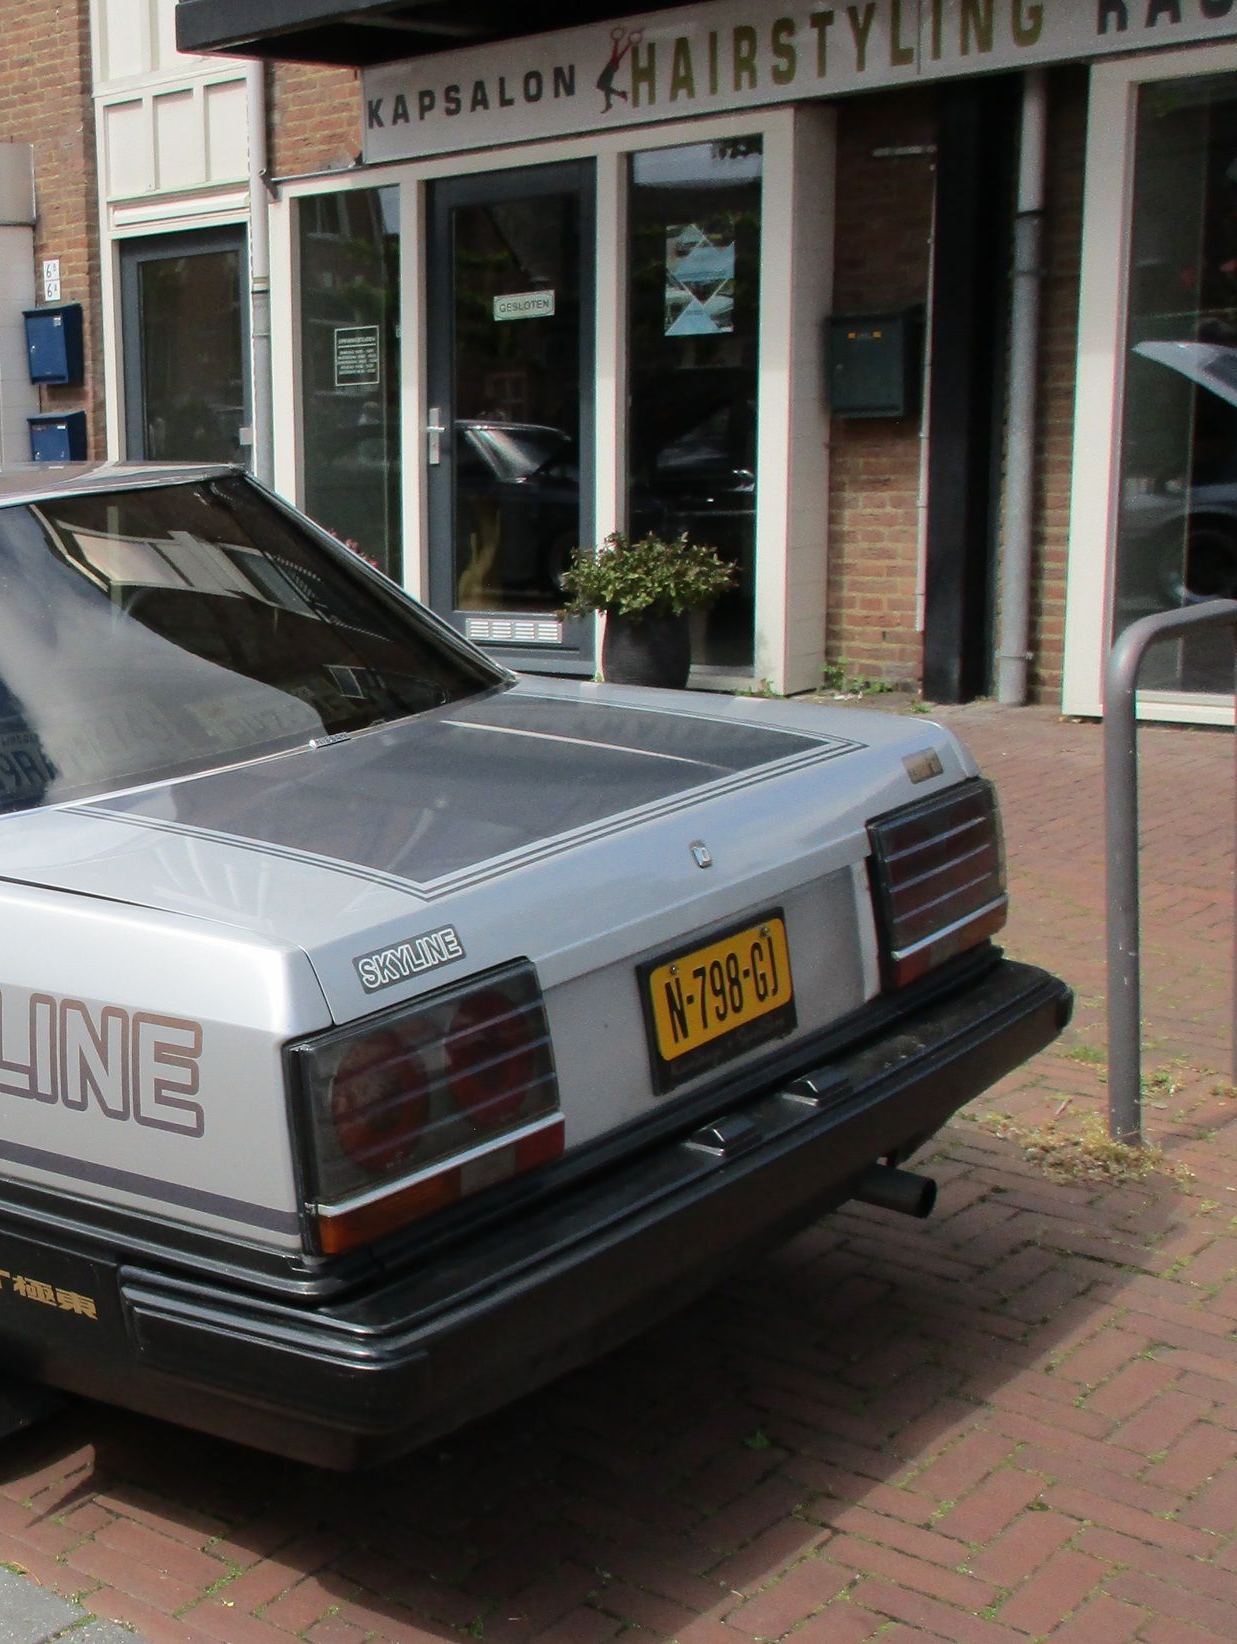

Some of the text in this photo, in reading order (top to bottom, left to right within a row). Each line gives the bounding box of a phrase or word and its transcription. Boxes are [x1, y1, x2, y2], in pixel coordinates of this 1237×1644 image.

[631, 0, 1044, 108] HAIRSTYLING
[367, 64, 576, 129] KAPSALON
[499, 299, 550, 313] GESLOTEN
[358, 928, 463, 988] SKYLINE
[665, 936, 779, 1044] N-798-GJ
